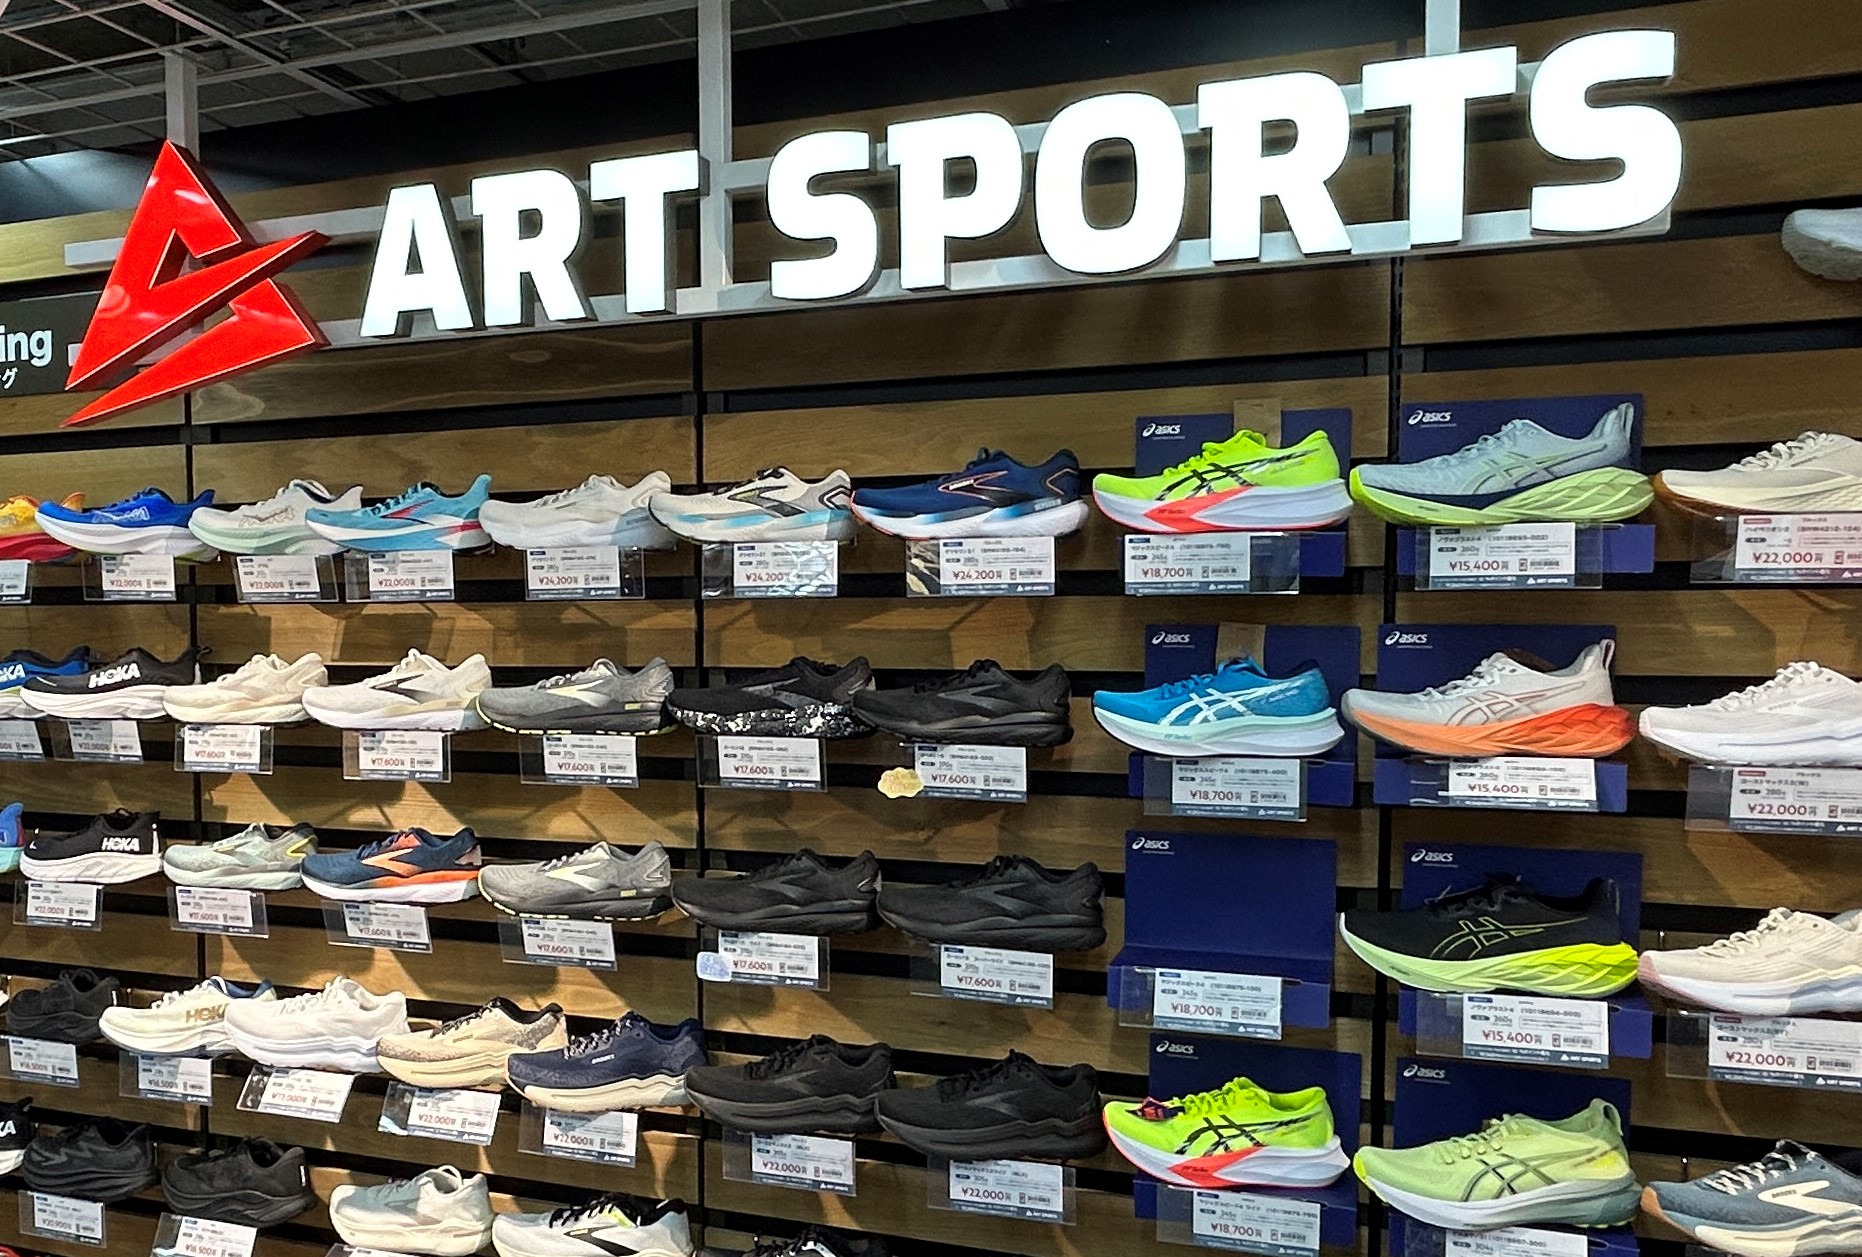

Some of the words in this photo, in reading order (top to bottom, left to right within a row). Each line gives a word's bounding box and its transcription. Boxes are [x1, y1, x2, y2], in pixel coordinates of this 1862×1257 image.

[361, 149, 703, 339] ART
[766, 29, 1685, 302] SPORTS
[1422, 412, 1451, 422] asics
[1154, 424, 1181, 435] asics
[1752, 552, 1812, 564] ¥22,000
[1449, 560, 1500, 572] ¥15,400
[953, 570, 995, 581] ¥24,200
[1141, 567, 1184, 578] ¥18,700
[1164, 633, 1190, 643] asics
[1398, 633, 1428, 643] asics
[88, 662, 142, 688] HOKA
[931, 774, 969, 784] ¥17,600
[1468, 783, 1519, 794] ¥15,400
[1190, 790, 1234, 802] ¥18,700
[1748, 803, 1807, 816] ¥22,000
[101, 837, 141, 852] HOKA
[1144, 839, 1170, 849] asics
[1425, 852, 1453, 862] asics
[957, 975, 995, 988] ¥17,600
[1170, 1002, 1214, 1016] ¥18,700
[1482, 1030, 1532, 1044] ¥15,400
[1168, 1043, 1194, 1054] asics
[1725, 1050, 1786, 1066] ¥22,000
[1417, 1067, 1445, 1078] asics
[961, 1187, 1005, 1200] ¥22,000
[1211, 1222, 1254, 1236] ¥18,700
